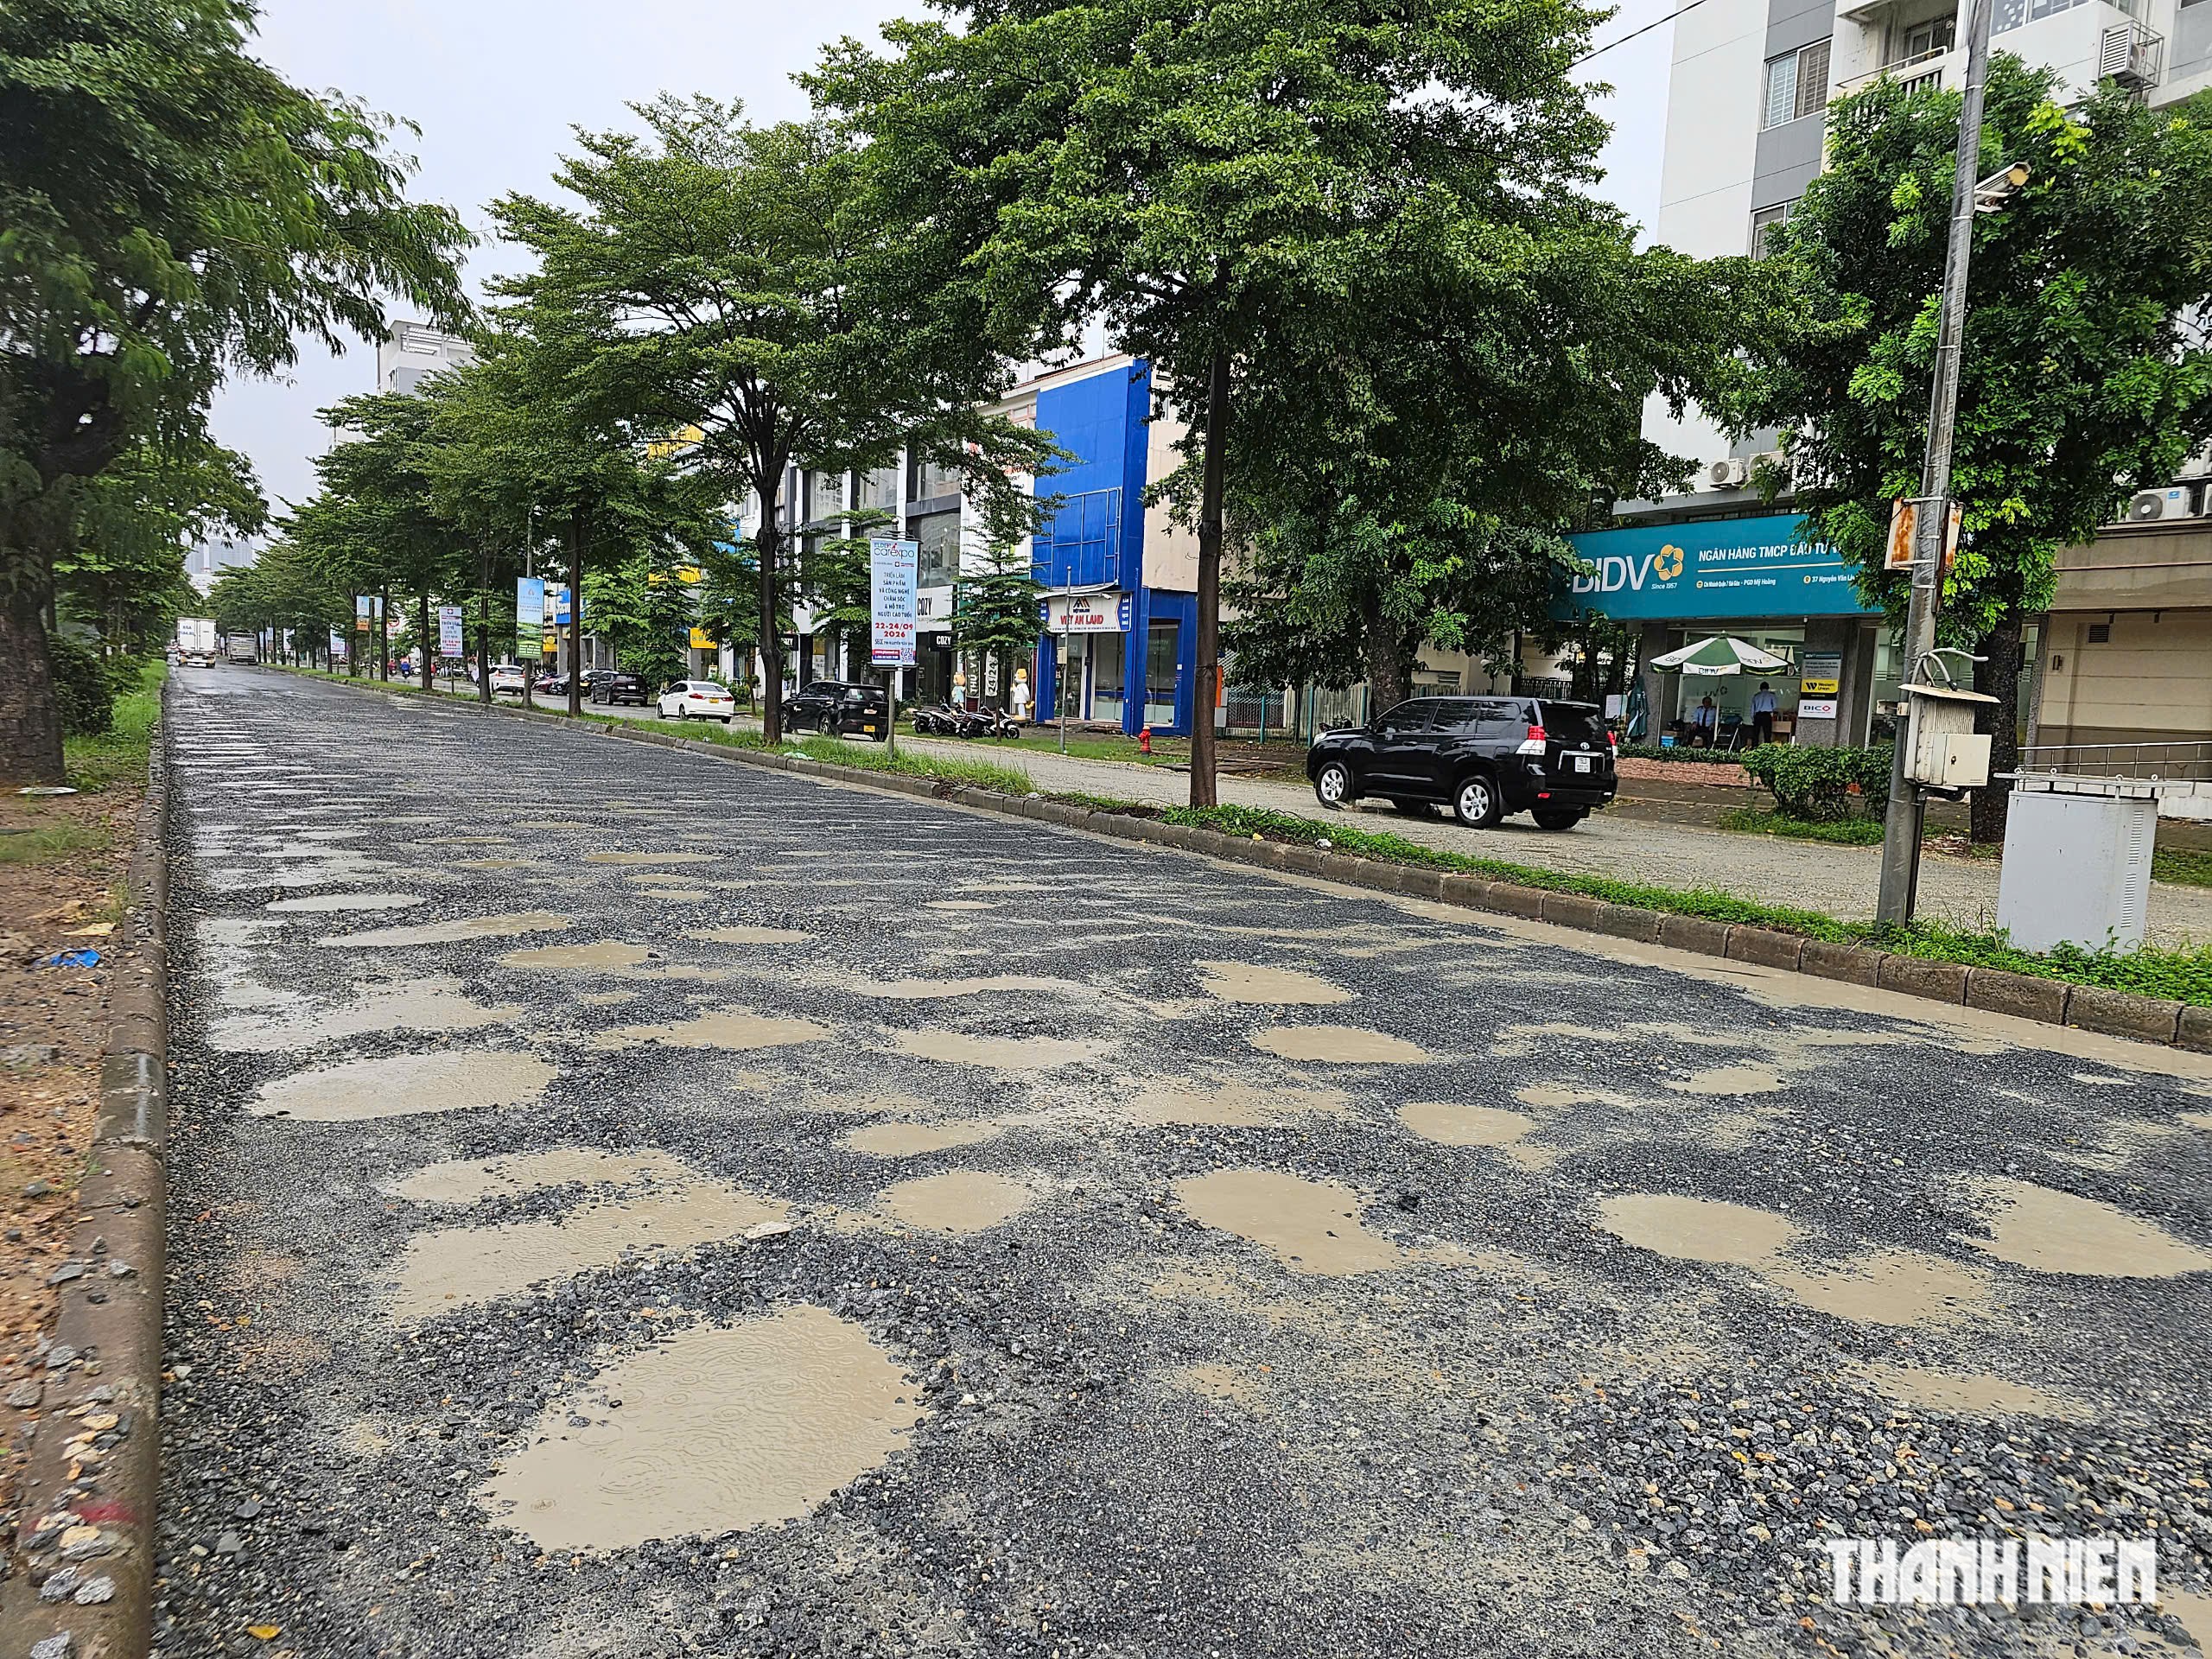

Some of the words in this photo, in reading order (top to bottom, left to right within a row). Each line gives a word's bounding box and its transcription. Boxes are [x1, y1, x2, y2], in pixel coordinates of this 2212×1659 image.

[1699, 549, 1726, 562] NGÂN
[1727, 546, 1757, 560] HÀNG
[1758, 544, 1787, 558] TMCP
[918, 597, 932, 616] COZY
[1085, 615, 1103, 625] LAND
[937, 635, 951, 645] COZY
